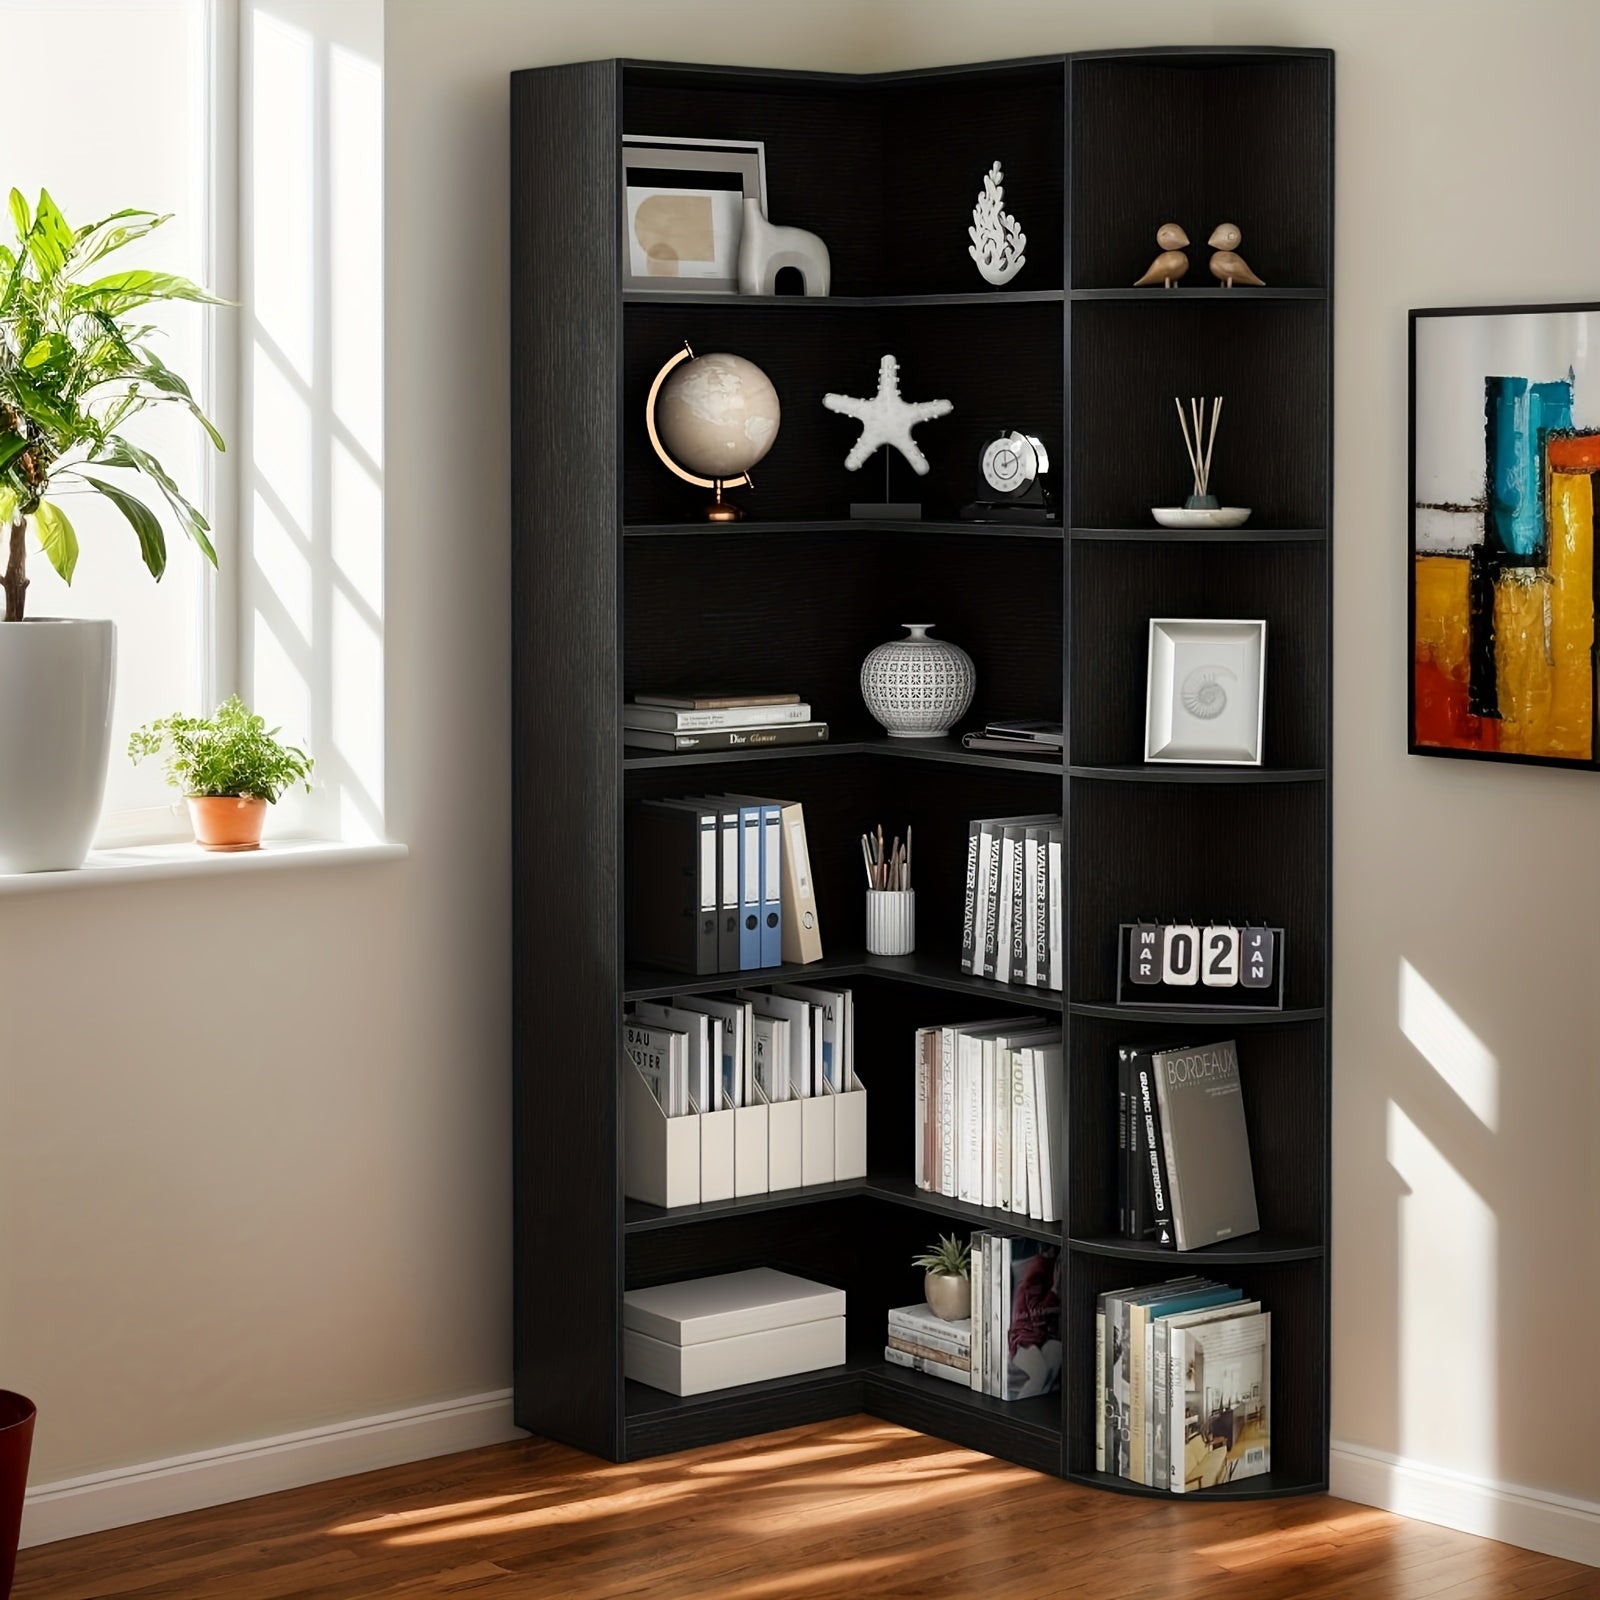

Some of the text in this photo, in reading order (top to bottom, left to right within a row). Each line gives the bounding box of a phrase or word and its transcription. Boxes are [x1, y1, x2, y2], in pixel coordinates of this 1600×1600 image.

[730, 734, 746, 745] Dior
[962, 890, 975, 950] FINANCE
[985, 894, 997, 954] FINANCE
[1013, 898, 1023, 958] FINANCE
[1037, 901, 1046, 963] FINANCE
[1140, 932, 1155, 976] MAR
[1251, 935, 1264, 978] JAN
[629, 1029, 650, 1047] BAU
[1167, 1049, 1235, 1084] BORDEAUX
